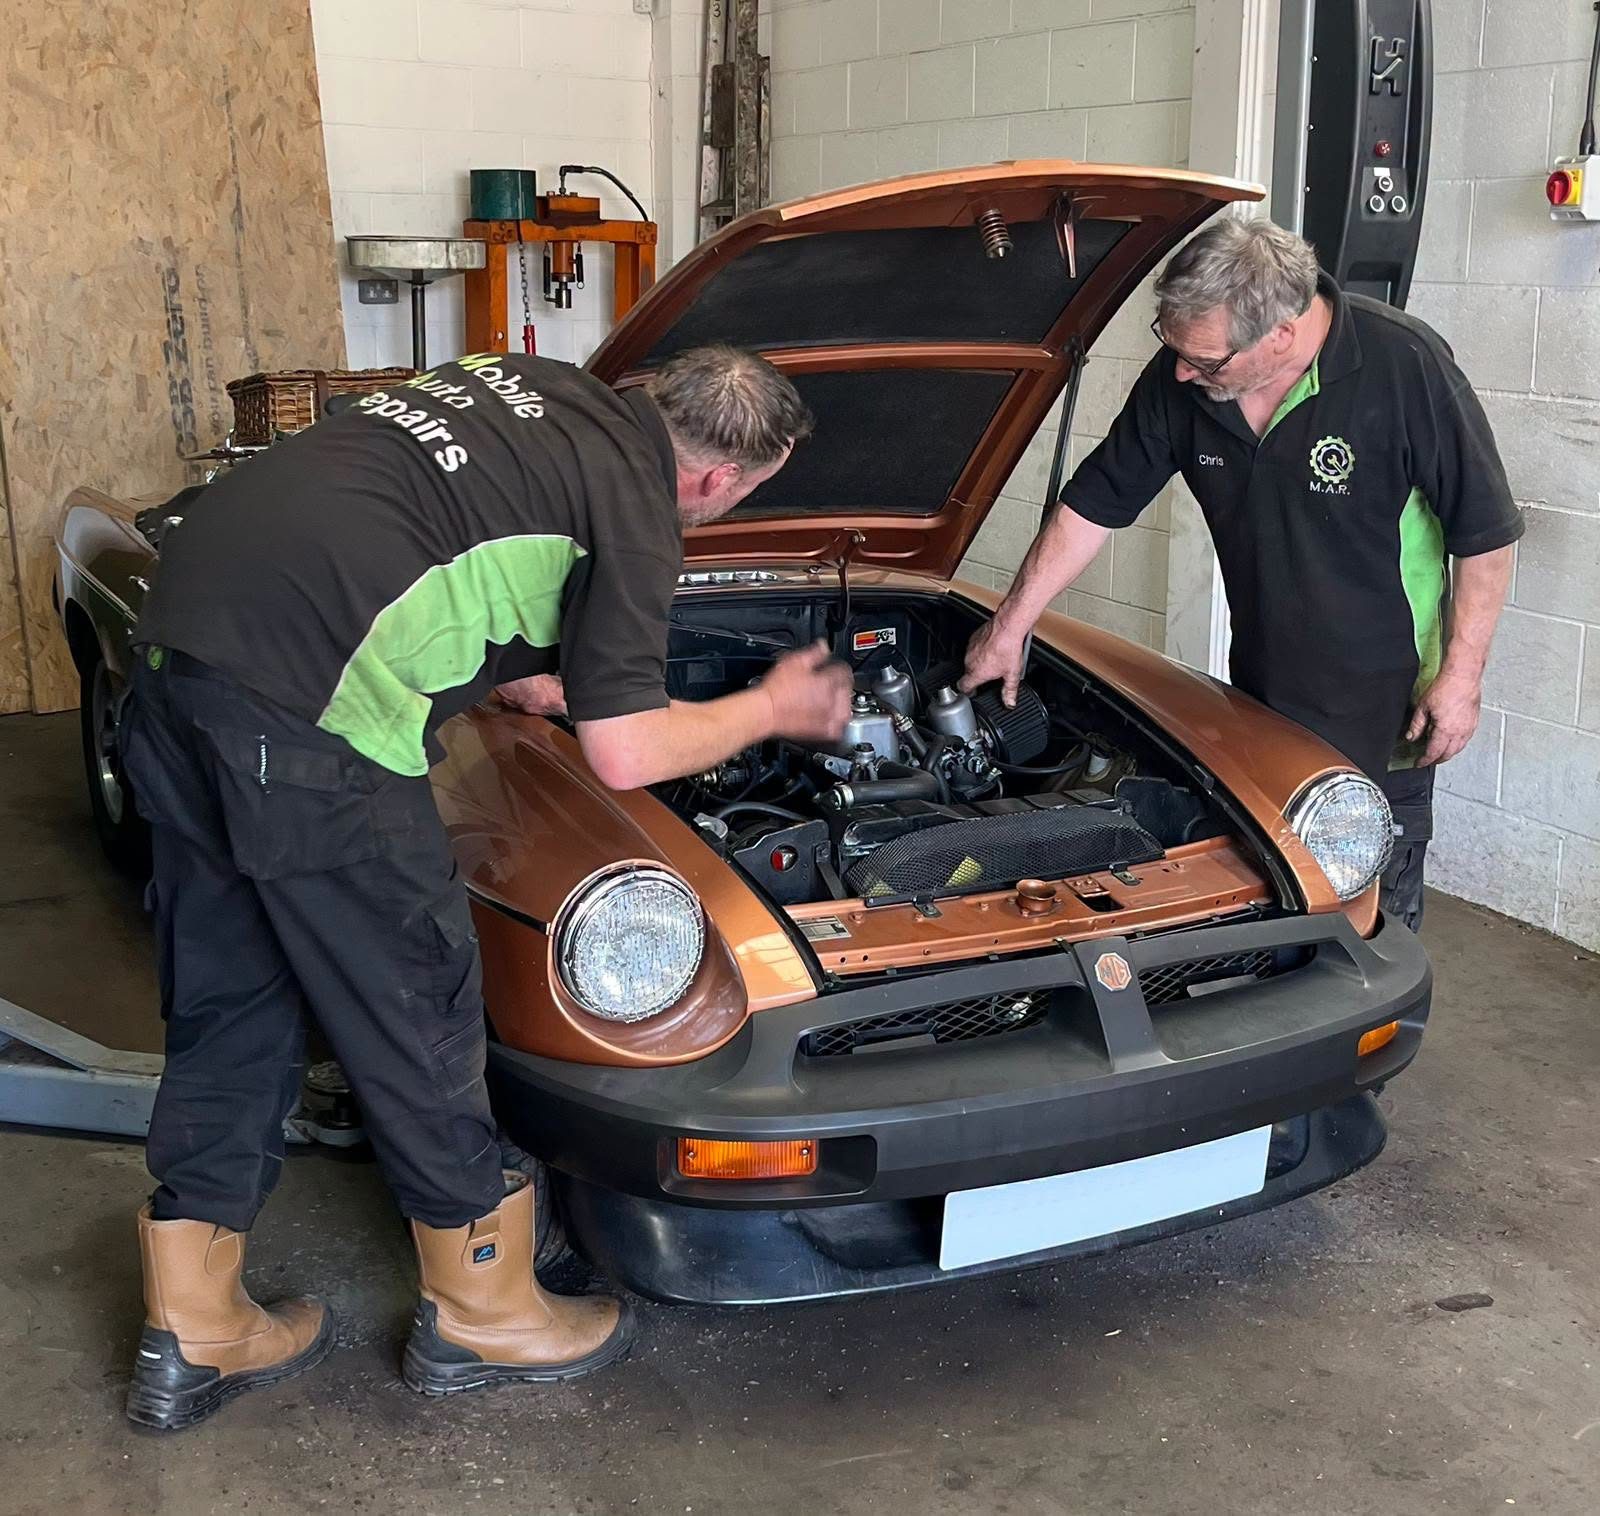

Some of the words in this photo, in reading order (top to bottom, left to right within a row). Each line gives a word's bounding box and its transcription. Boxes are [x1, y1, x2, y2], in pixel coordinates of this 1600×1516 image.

[400, 371, 474, 410] Auto
[457, 352, 545, 419] Mobile
[351, 391, 468, 473] epairs
[1198, 454, 1224, 467] Chris
[1309, 480, 1351, 496] M.A.R.
